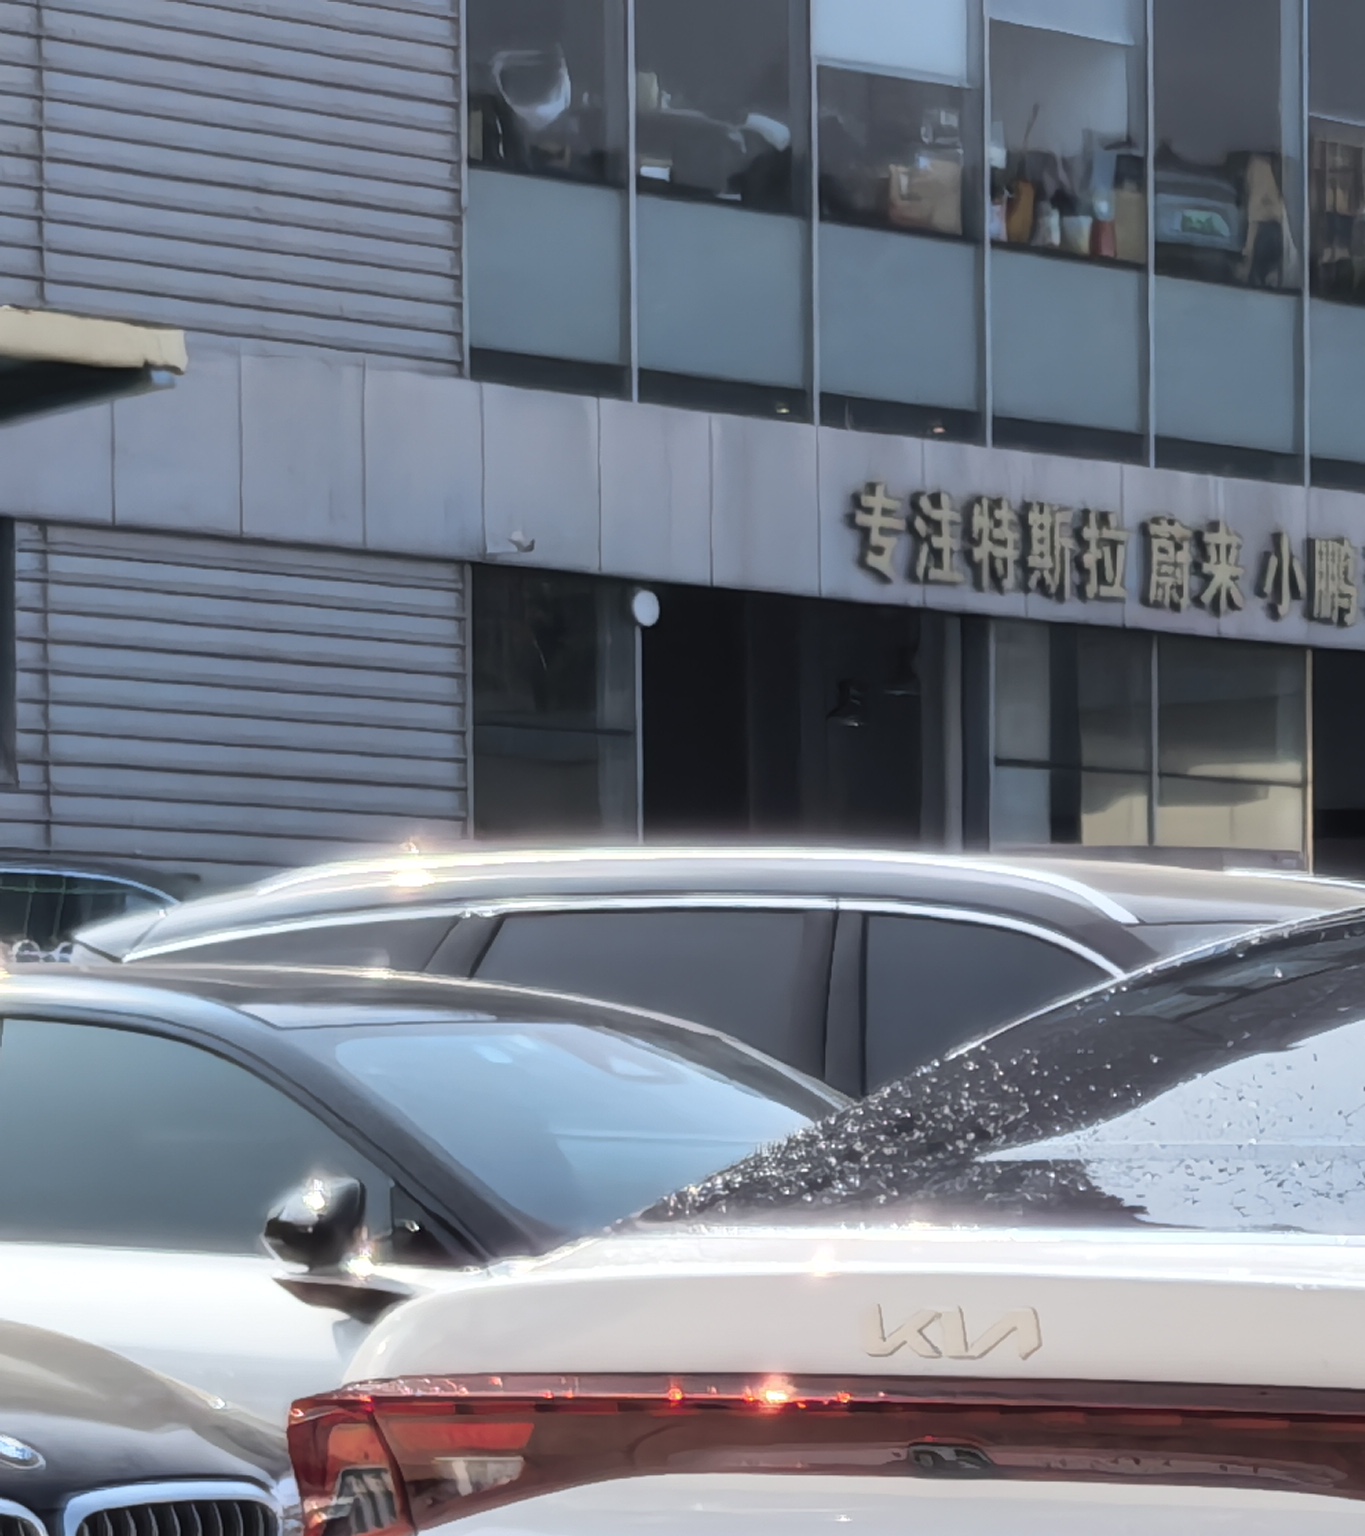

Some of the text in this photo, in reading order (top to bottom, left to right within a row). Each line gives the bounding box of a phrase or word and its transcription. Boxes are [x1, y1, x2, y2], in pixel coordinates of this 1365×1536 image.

[852, 482, 1128, 603] 专注特斯拉
[1145, 515, 1244, 615] 蔚来
[1262, 531, 1358, 627] 小鹏
[862, 1303, 1043, 1361] KIA
